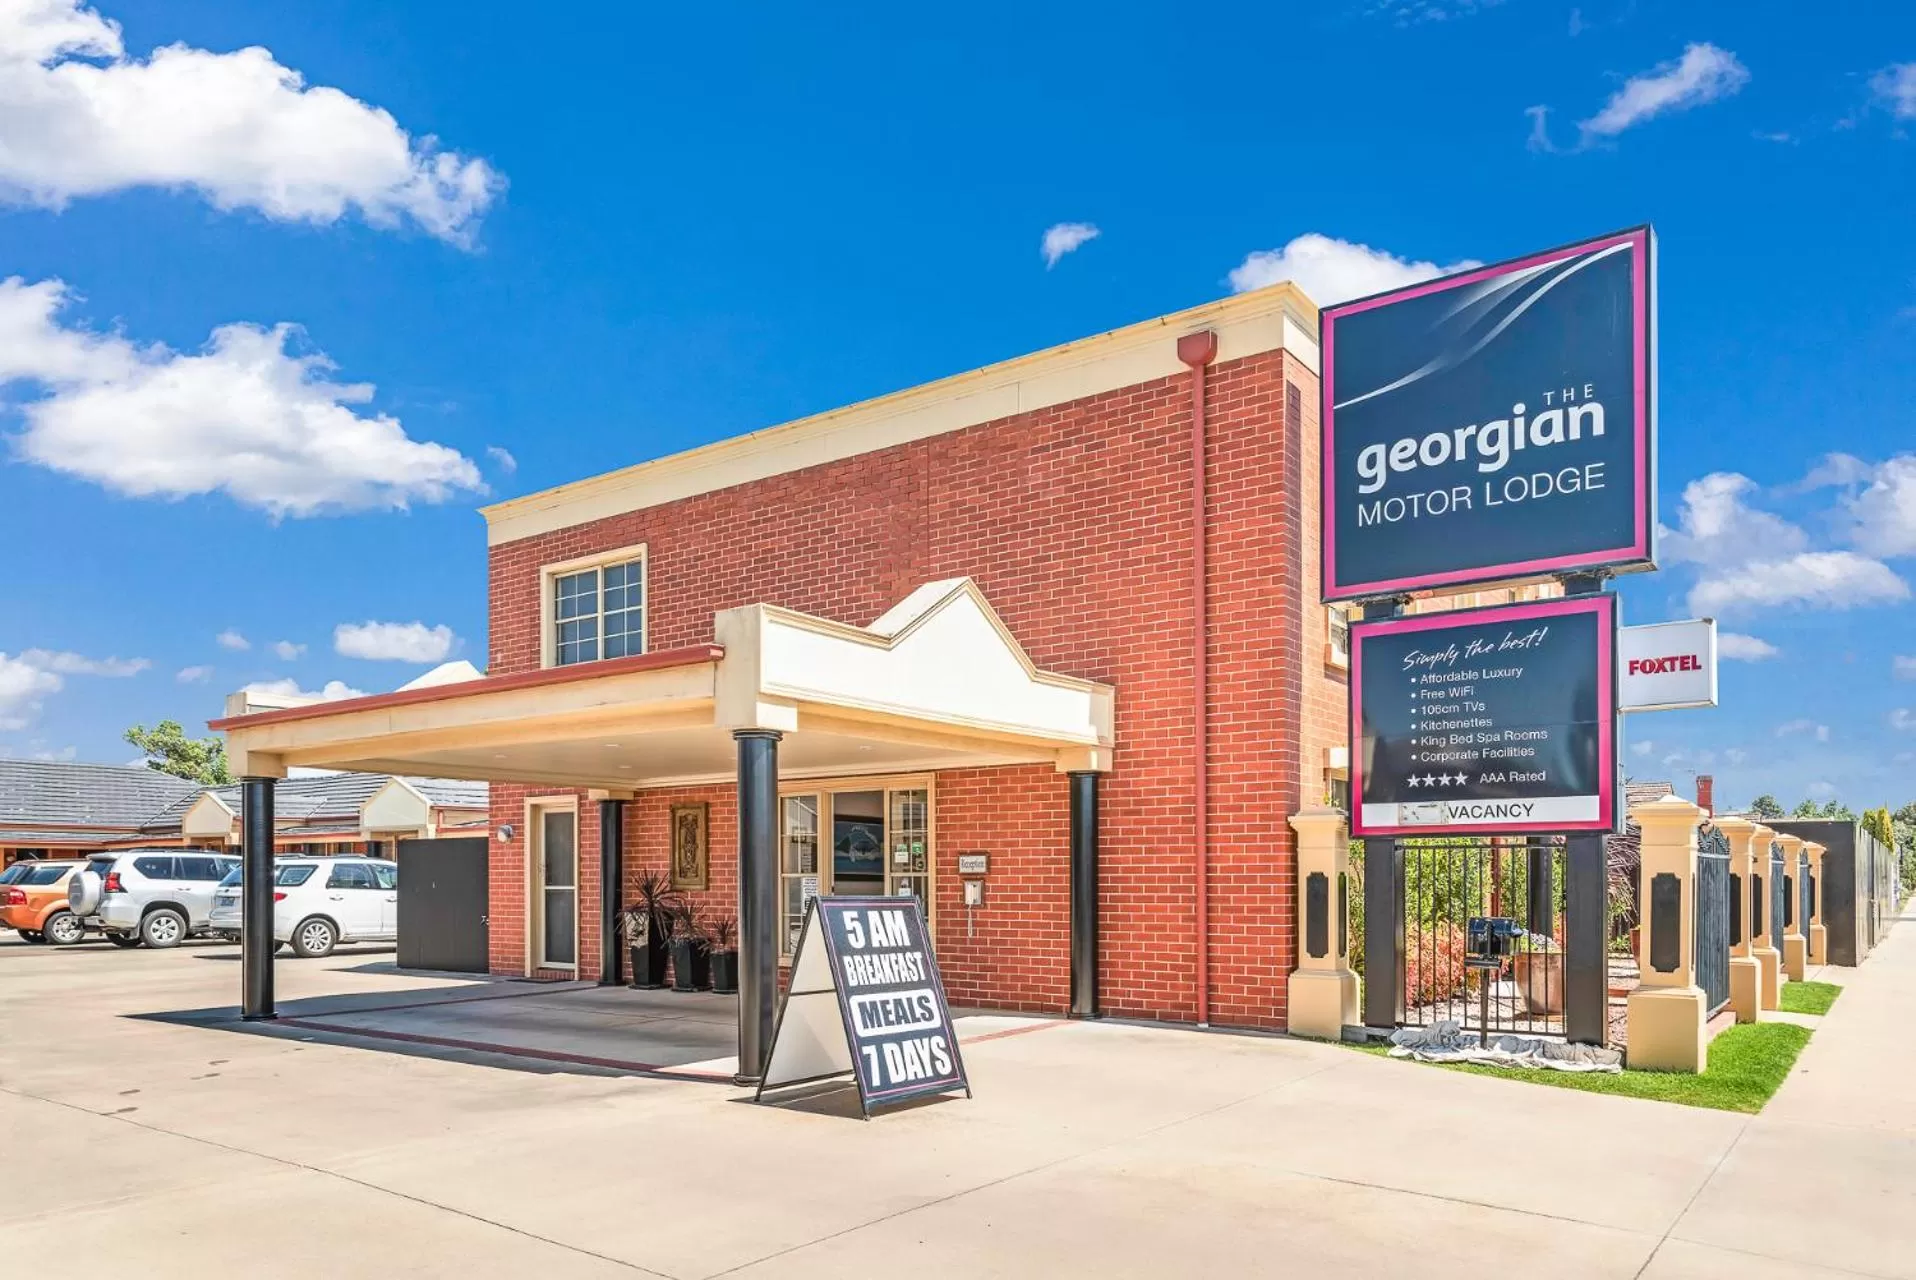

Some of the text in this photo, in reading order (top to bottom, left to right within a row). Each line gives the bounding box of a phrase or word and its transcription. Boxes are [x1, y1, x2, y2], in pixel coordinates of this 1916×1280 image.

[1543, 384, 1594, 406] THE
[1357, 402, 1605, 494] georgian
[1358, 463, 1605, 527] MOTOR LODGE
[1403, 626, 1548, 671] Simply the best!
[1629, 655, 1702, 675] FOXTEL
[1420, 667, 1523, 684] Affordable Luxury
[1420, 685, 1474, 699] Free WiFi
[1463, 701, 1486, 712] TVs
[1420, 718, 1493, 731] Kitchenettes
[1420, 730, 1548, 748] King Bed Spa Rooms
[1420, 747, 1535, 763] Corporate Facilities
[1480, 770, 1547, 784] AAA Rated
[1448, 803, 1534, 819] VACANCY
[843, 910, 911, 949] 5 AM
[843, 951, 926, 987] BREAKFAST
[857, 995, 935, 1030] MEALS
[861, 1036, 951, 1087] 7 DAYS
